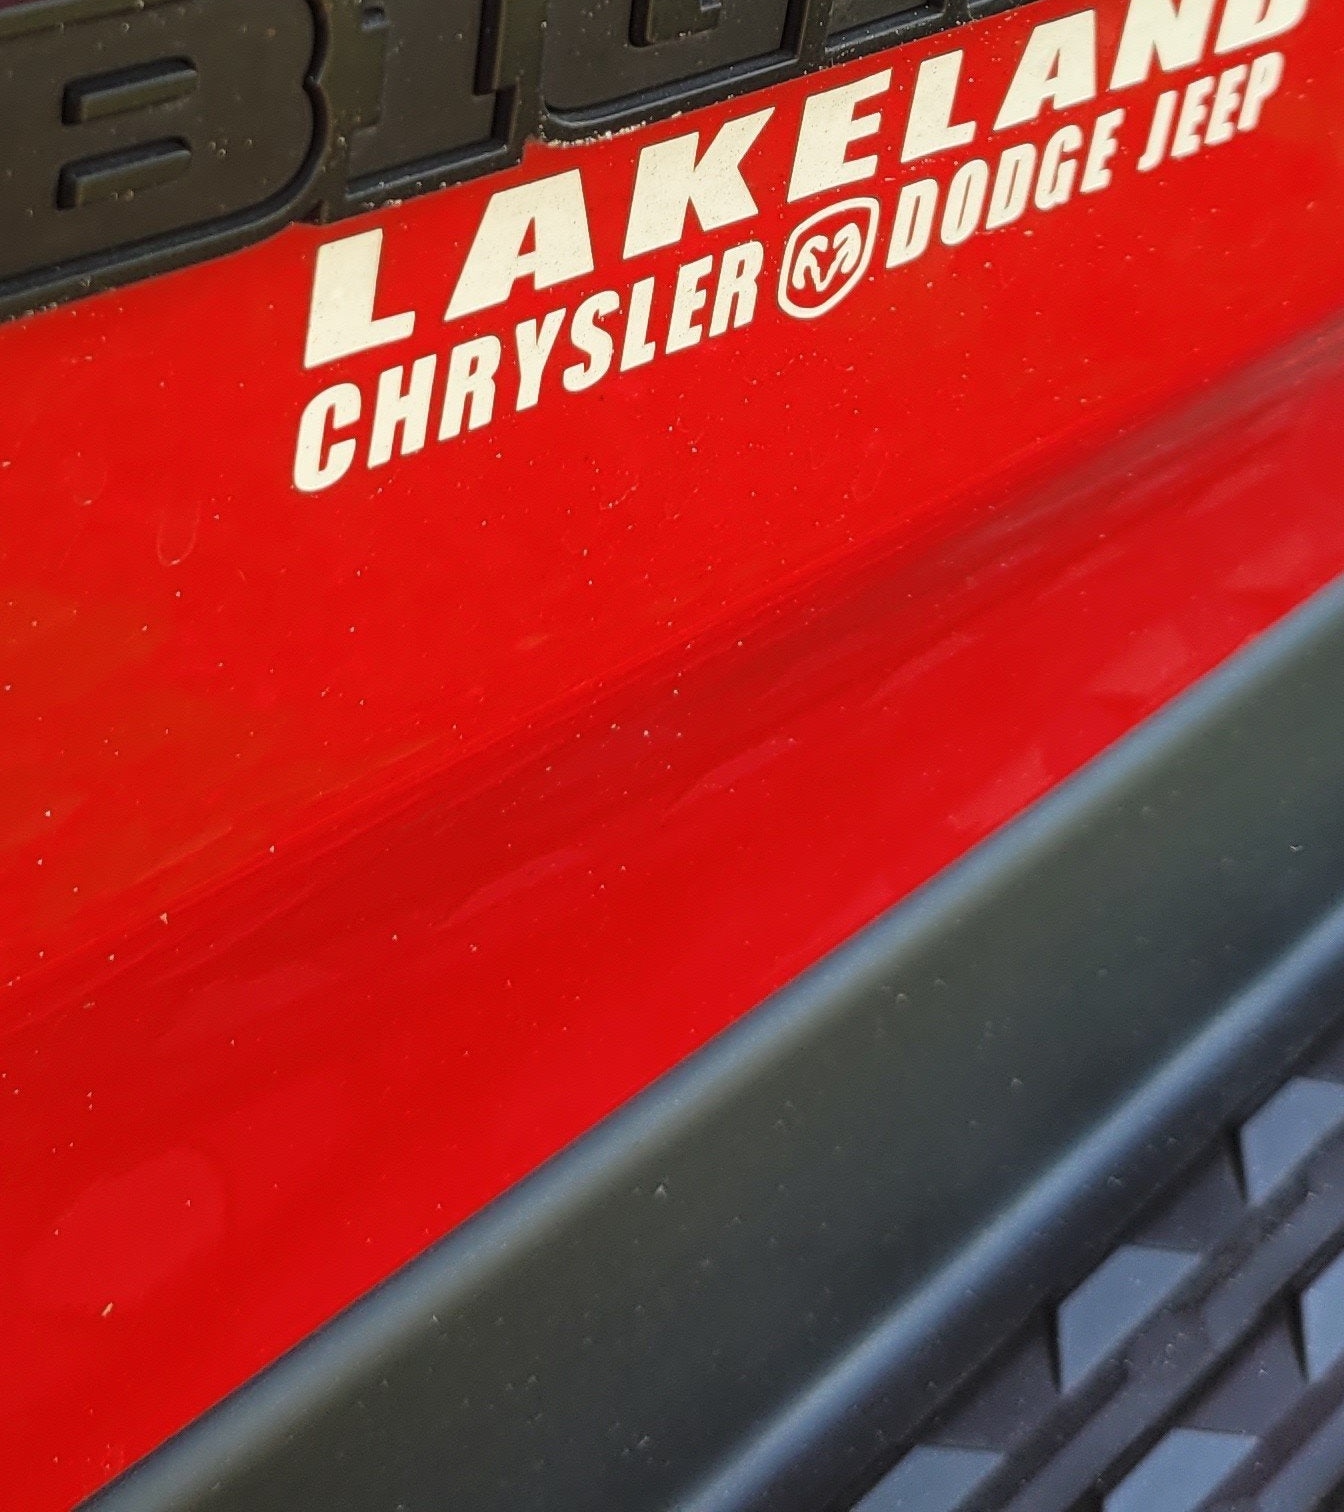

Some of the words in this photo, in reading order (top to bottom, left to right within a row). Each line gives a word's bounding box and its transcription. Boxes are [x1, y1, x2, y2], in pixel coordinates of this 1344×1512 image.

[292, 238, 765, 494] CHRYSLER
[884, 107, 1126, 270] DODGE
[1136, 50, 1285, 173] JEEP
